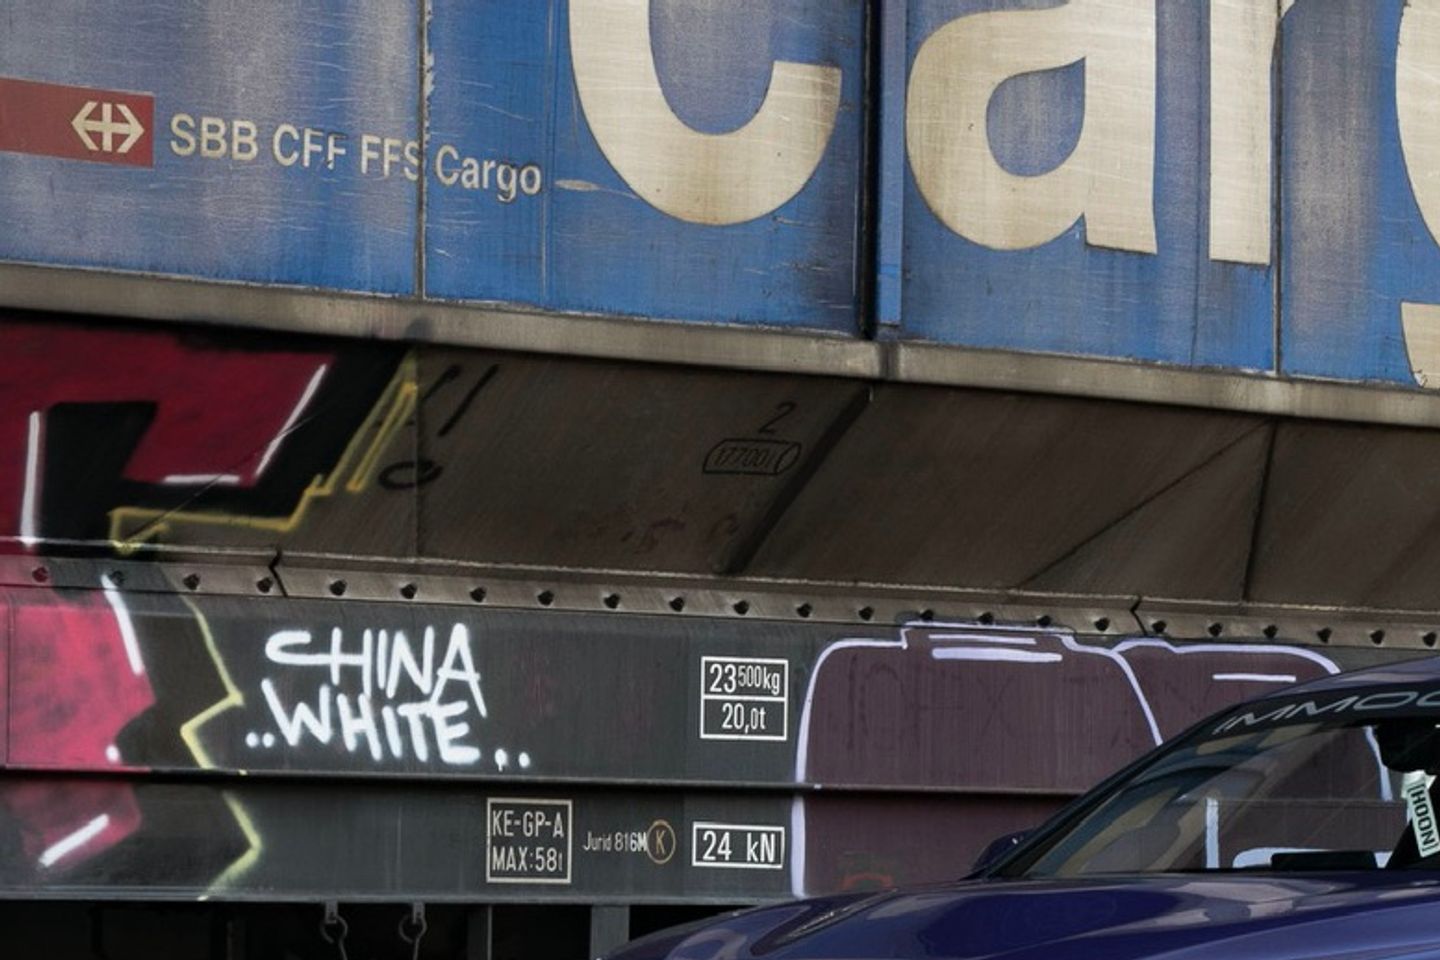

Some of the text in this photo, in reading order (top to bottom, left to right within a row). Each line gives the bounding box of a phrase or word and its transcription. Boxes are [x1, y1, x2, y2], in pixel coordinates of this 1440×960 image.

[170, 113, 542, 203] SBB CFF FFS Cargo
[265, 622, 487, 718] CHINA
[491, 809, 565, 838] KE-GP-A
[582, 831, 612, 852] Jurid
[702, 830, 776, 863] 24 kN
